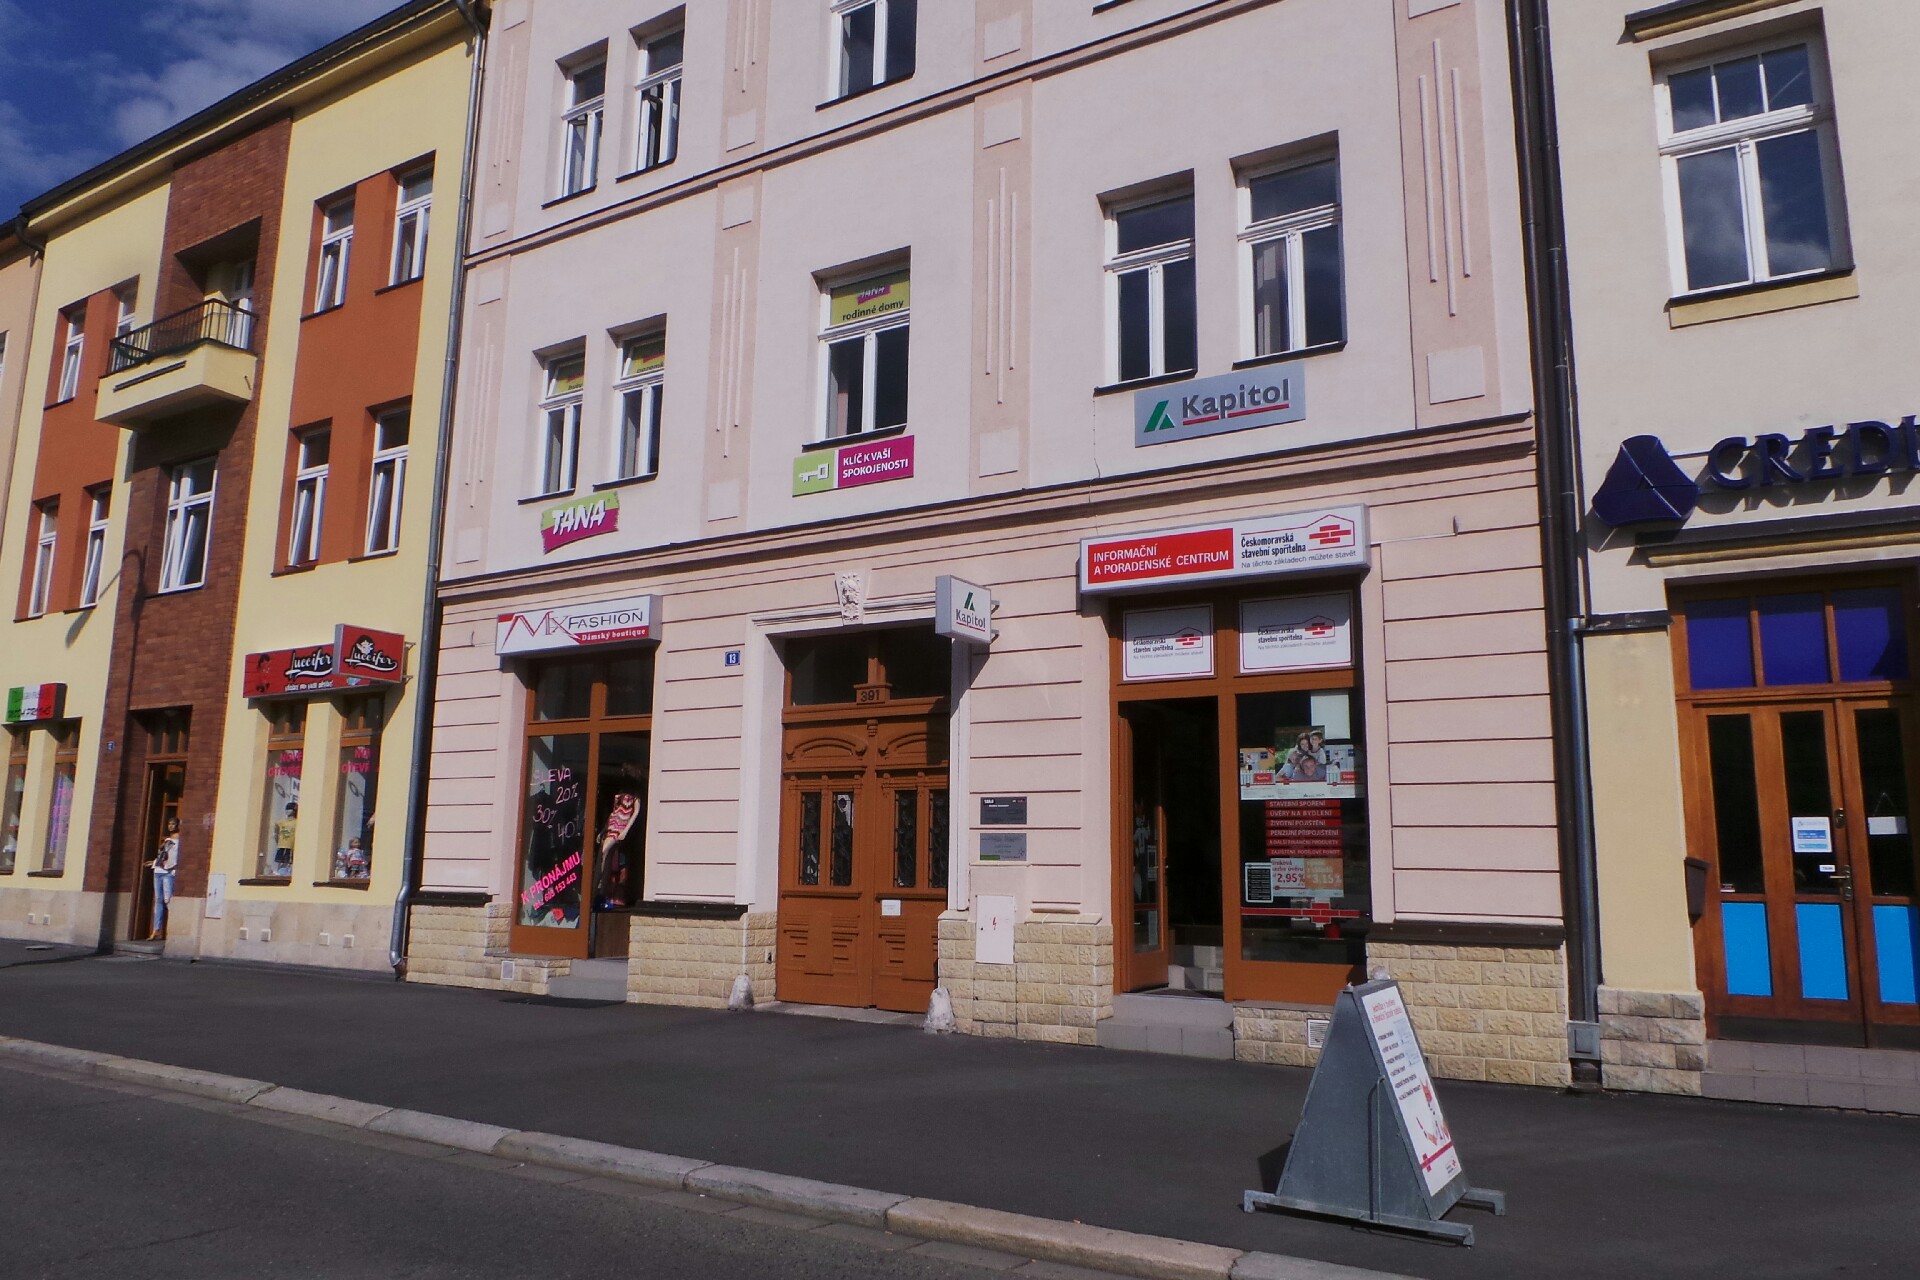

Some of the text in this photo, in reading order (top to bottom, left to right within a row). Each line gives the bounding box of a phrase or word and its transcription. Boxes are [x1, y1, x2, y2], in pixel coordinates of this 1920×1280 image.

[842, 299, 904, 321] rodinné domy
[1182, 378, 1290, 419] Kapitol
[843, 448, 891, 467] KLÍČ K VAŠÍ
[842, 458, 909, 478] SPOKOJENOSTI
[552, 500, 606, 535] TANA
[1241, 533, 1294, 548] Českomoravská
[1093, 544, 1158, 563] INFORMAČNÍ
[1241, 544, 1306, 559] stavební spořitelna
[1252, 559, 1272, 567] těchto
[1274, 556, 1307, 565] základech
[1335, 550, 1356, 559] stavět
[1094, 551, 1229, 576] A PORADENSKÉ CENTRUM
[568, 609, 644, 630] FASHION
[956, 609, 986, 628] Kapitol
[582, 628, 646, 642] Dámský boutique
[344, 647, 398, 671] Luccifer
[729, 653, 737, 664] 13
[860, 689, 880, 702] 391
[555, 782, 578, 804] 20%
[521, 851, 580, 905] K PRONÁJMU
